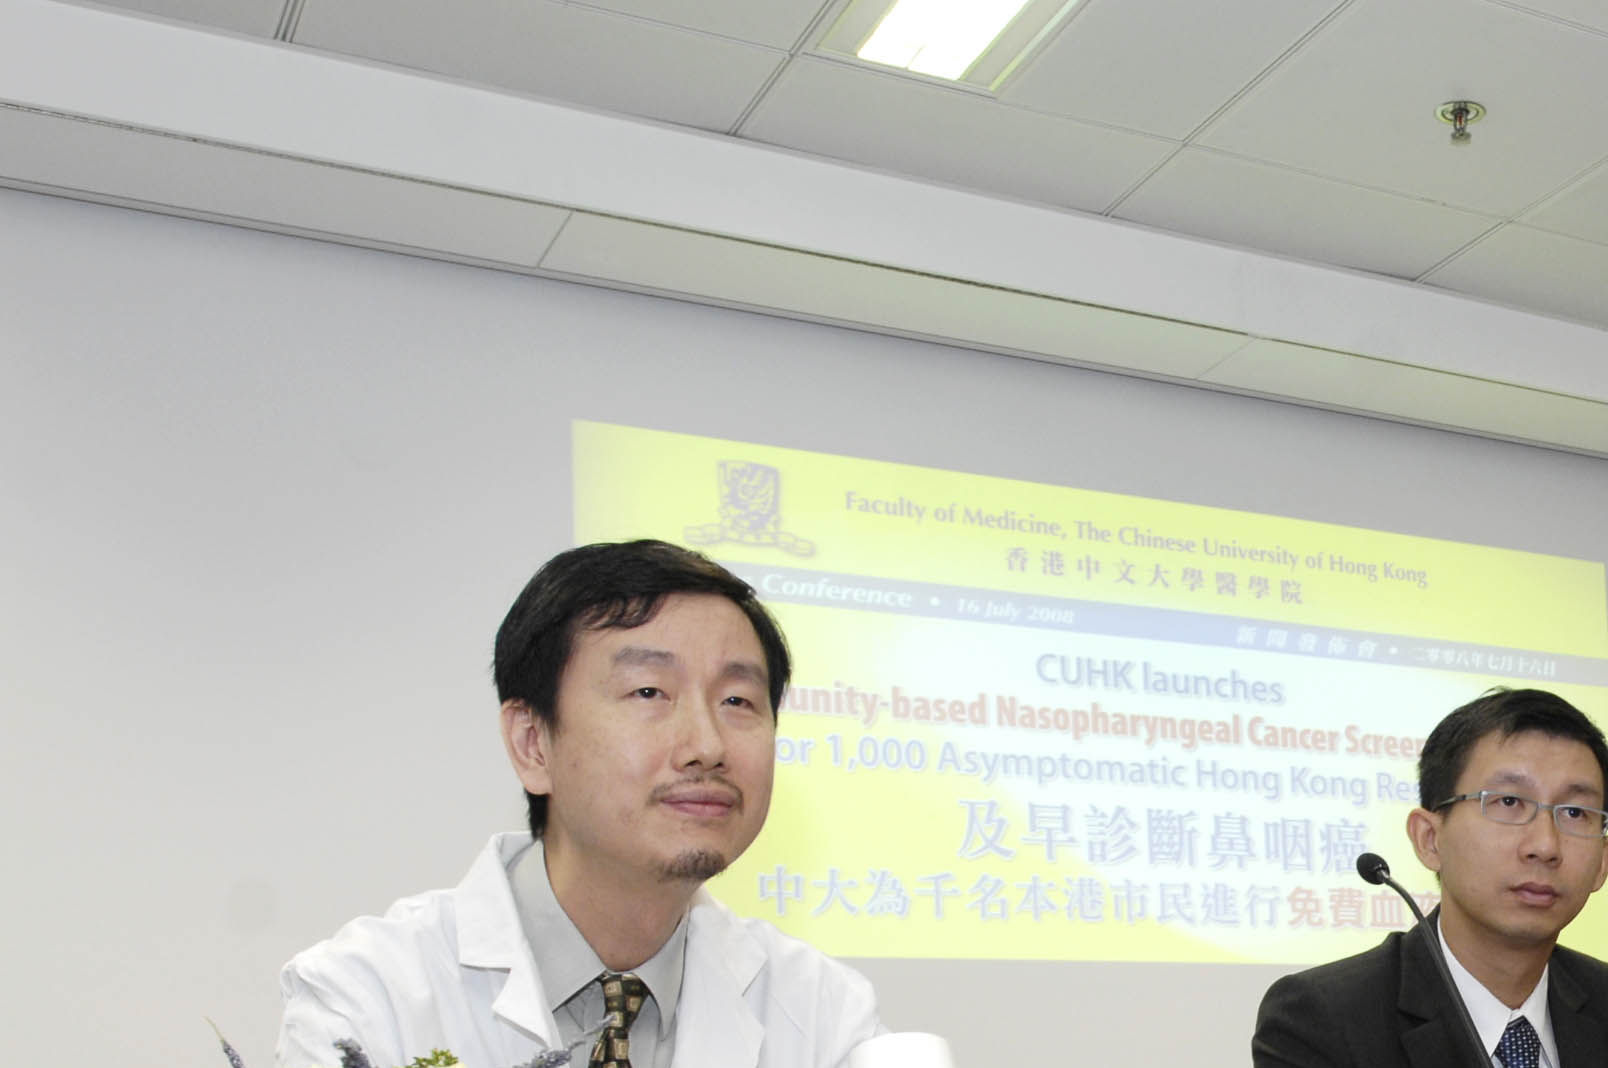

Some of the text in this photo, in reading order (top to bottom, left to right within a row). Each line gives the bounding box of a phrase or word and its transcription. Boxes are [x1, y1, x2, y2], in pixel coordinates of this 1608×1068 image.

[844, 491, 1429, 590] Faculty of Medicine, The Chinese University of Hong Kong
[1006, 546, 1304, 605] 香港中文大學醫學院
[762, 573, 913, 609] Conference
[957, 598, 980, 616] 16
[983, 601, 1021, 622] July
[1026, 606, 1075, 625] 2008
[1035, 653, 1285, 704] CUHK launches
[781, 681, 987, 728] unity-based
[996, 695, 1241, 748] Nasopharyngeal
[1247, 716, 1339, 753] Cancer
[775, 737, 816, 763] or
[826, 735, 926, 771] 1,000
[938, 742, 1186, 786] Asymptomatic
[1196, 760, 1280, 801] Hong
[1290, 766, 1367, 805] Kong
[957, 799, 1368, 873] 及早診斷鼻咽癌
